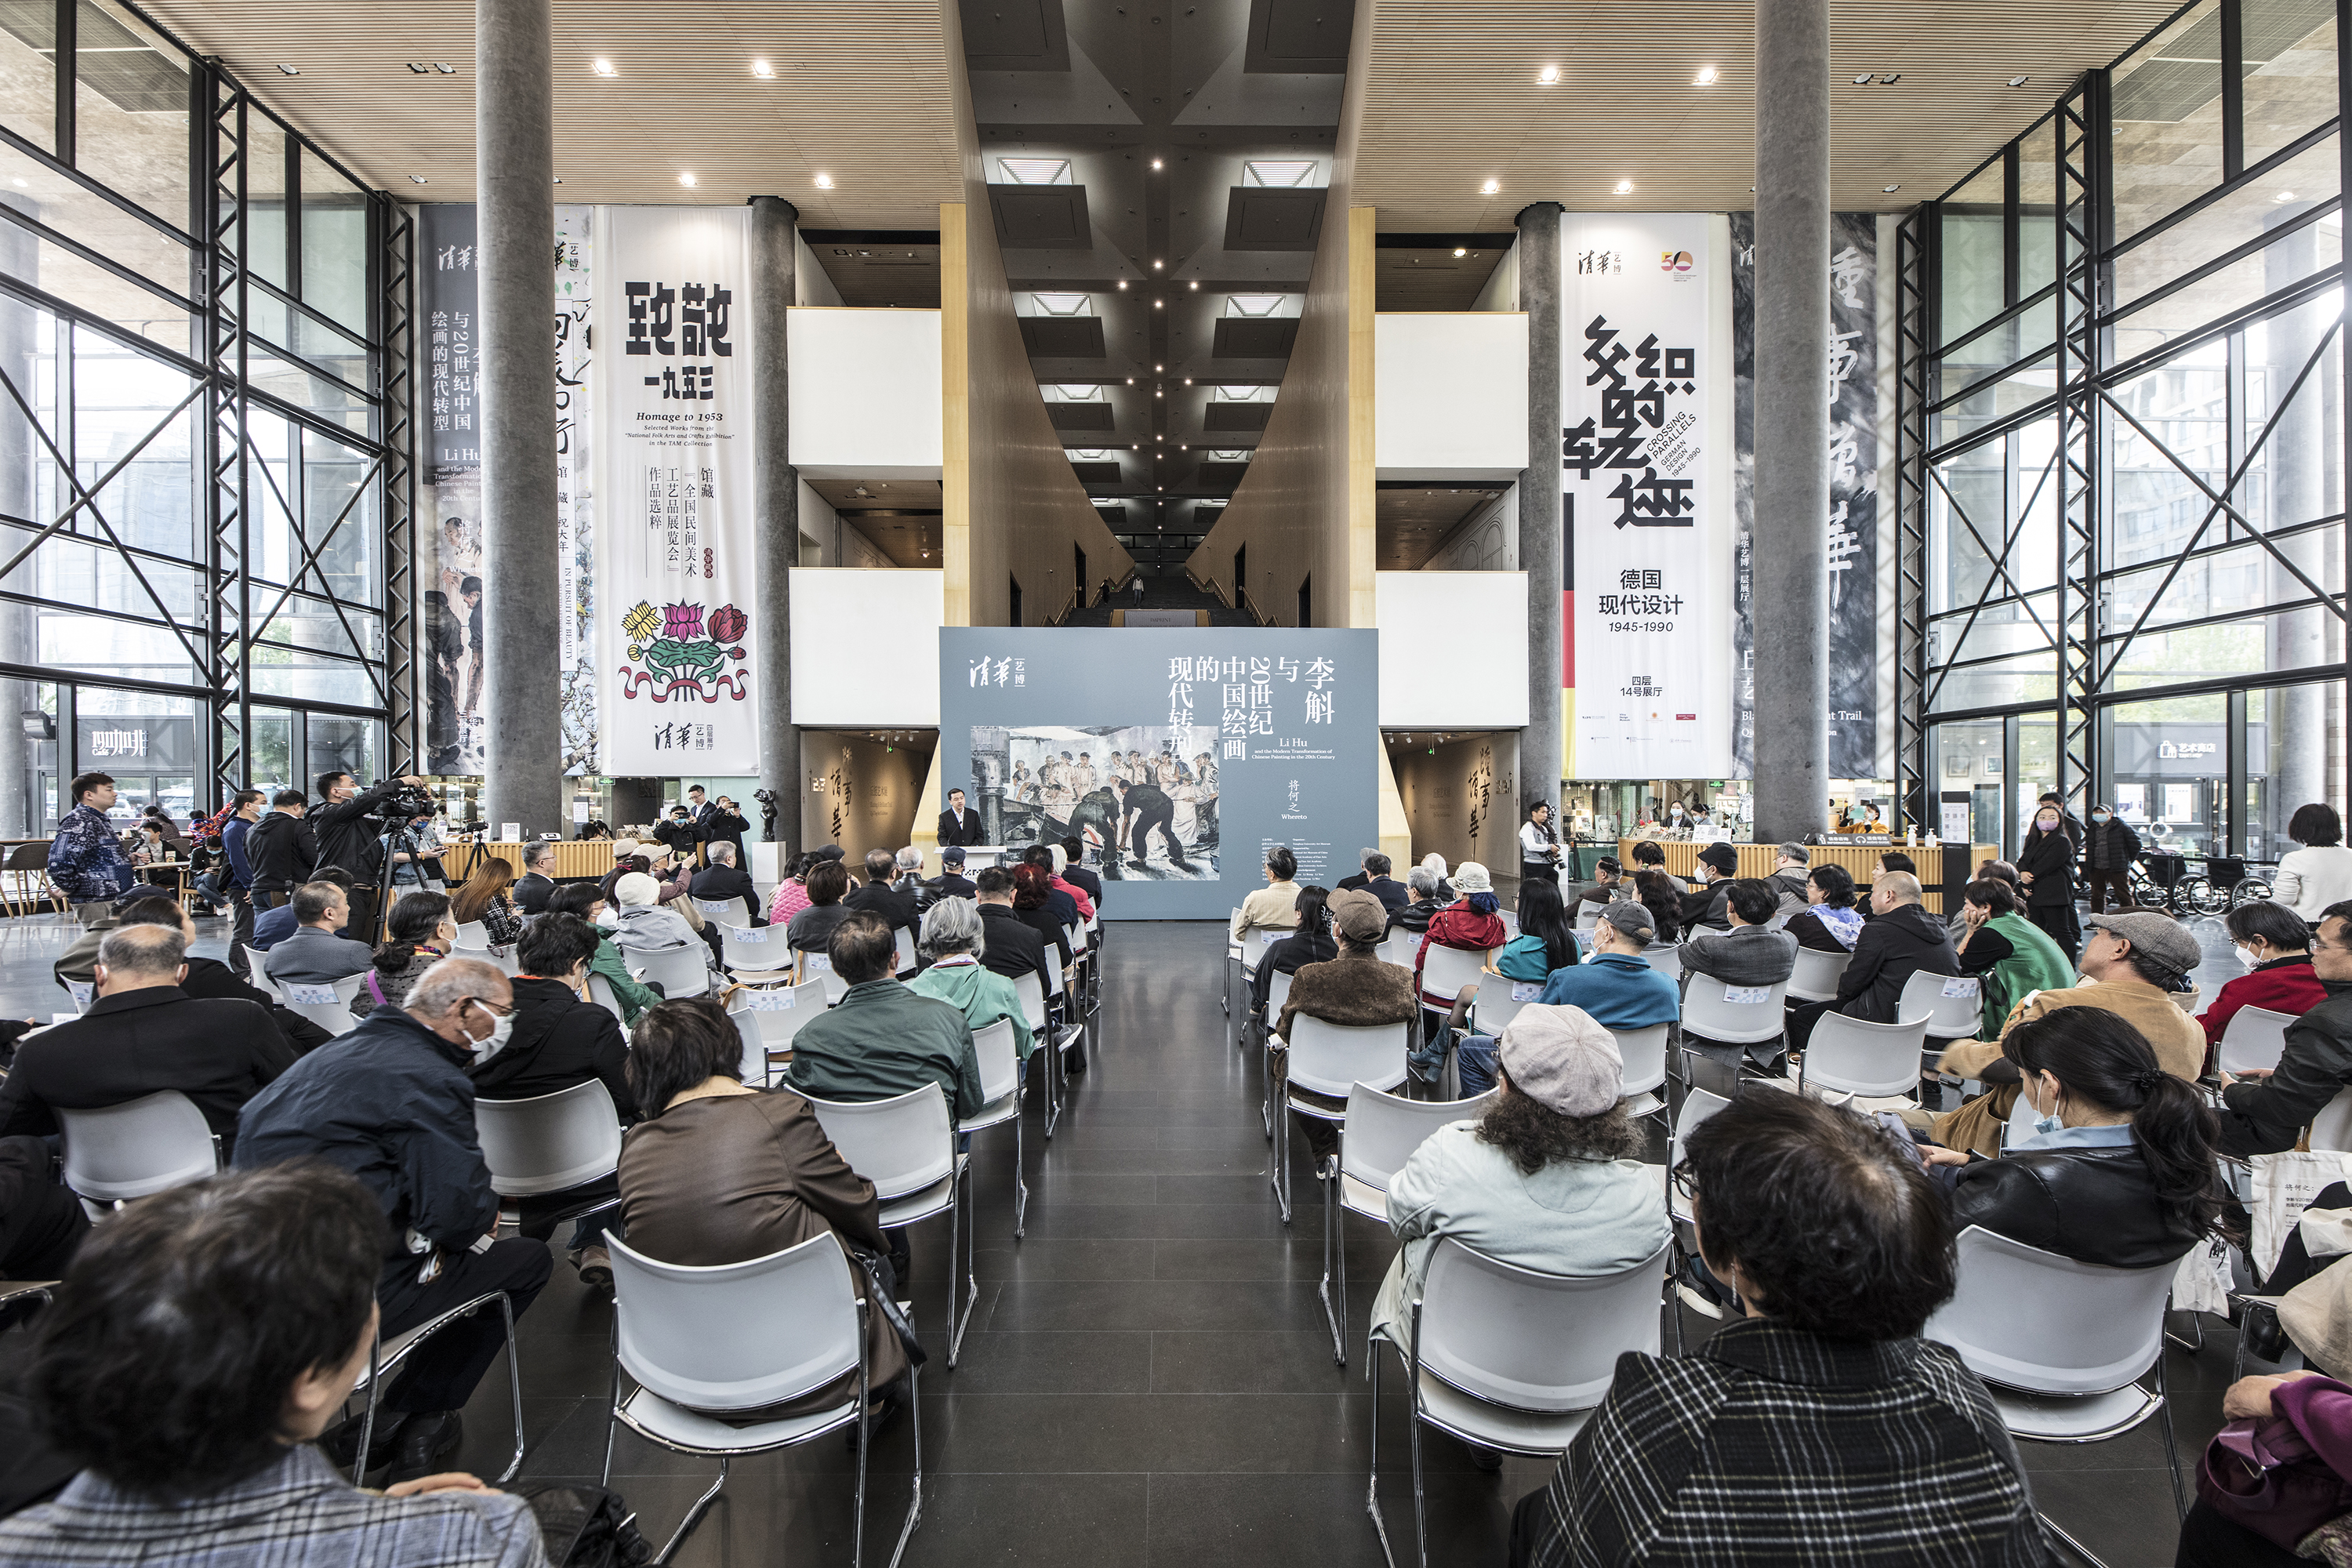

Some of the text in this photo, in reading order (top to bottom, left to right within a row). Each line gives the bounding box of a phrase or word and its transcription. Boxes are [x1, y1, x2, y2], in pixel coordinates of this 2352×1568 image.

[1613, 252, 1622, 274] 艺博
[1661, 250, 1693, 272] 50
[625, 281, 732, 357] 致敬
[432, 310, 451, 431] 绘画的现代转型
[452, 311, 472, 430] 与20世纪中国
[644, 365, 713, 401] 一九五三
[636, 412, 681, 423] Homage
[698, 412, 724, 422] 1953
[1646, 411, 1686, 452] CROSSING
[1652, 413, 1697, 459] PARALLELS
[444, 448, 481, 461] Li Hu
[1661, 439, 1686, 466] GERMAN
[1665, 448, 1688, 472] DESIGN
[701, 466, 714, 499] 馆藏
[648, 466, 662, 530] 作品选粹
[564, 567, 572, 576] IN
[1620, 568, 1662, 590] 德国
[1739, 531, 1750, 602] 清华艺博一层展厅
[1599, 594, 1684, 615] 现代设计
[565, 615, 572, 626] OF
[1609, 622, 1674, 632] 1945-1990
[1014, 659, 1025, 687] 艺博
[1196, 655, 1220, 683] 的
[1275, 656, 1301, 683] 与
[1632, 676, 1652, 686] 四层
[1247, 655, 1274, 735] 20世纪
[1305, 655, 1336, 725] 李斛
[1620, 687, 1663, 697] 14号展厅
[1167, 655, 1195, 761] 现代转型
[1221, 655, 1247, 761] 中国绘画
[1838, 710, 1862, 720] Trail
[695, 724, 705, 750] 艺博
[1279, 738, 1308, 747] Li Hu
[2178, 742, 2216, 753] 艺术商店
